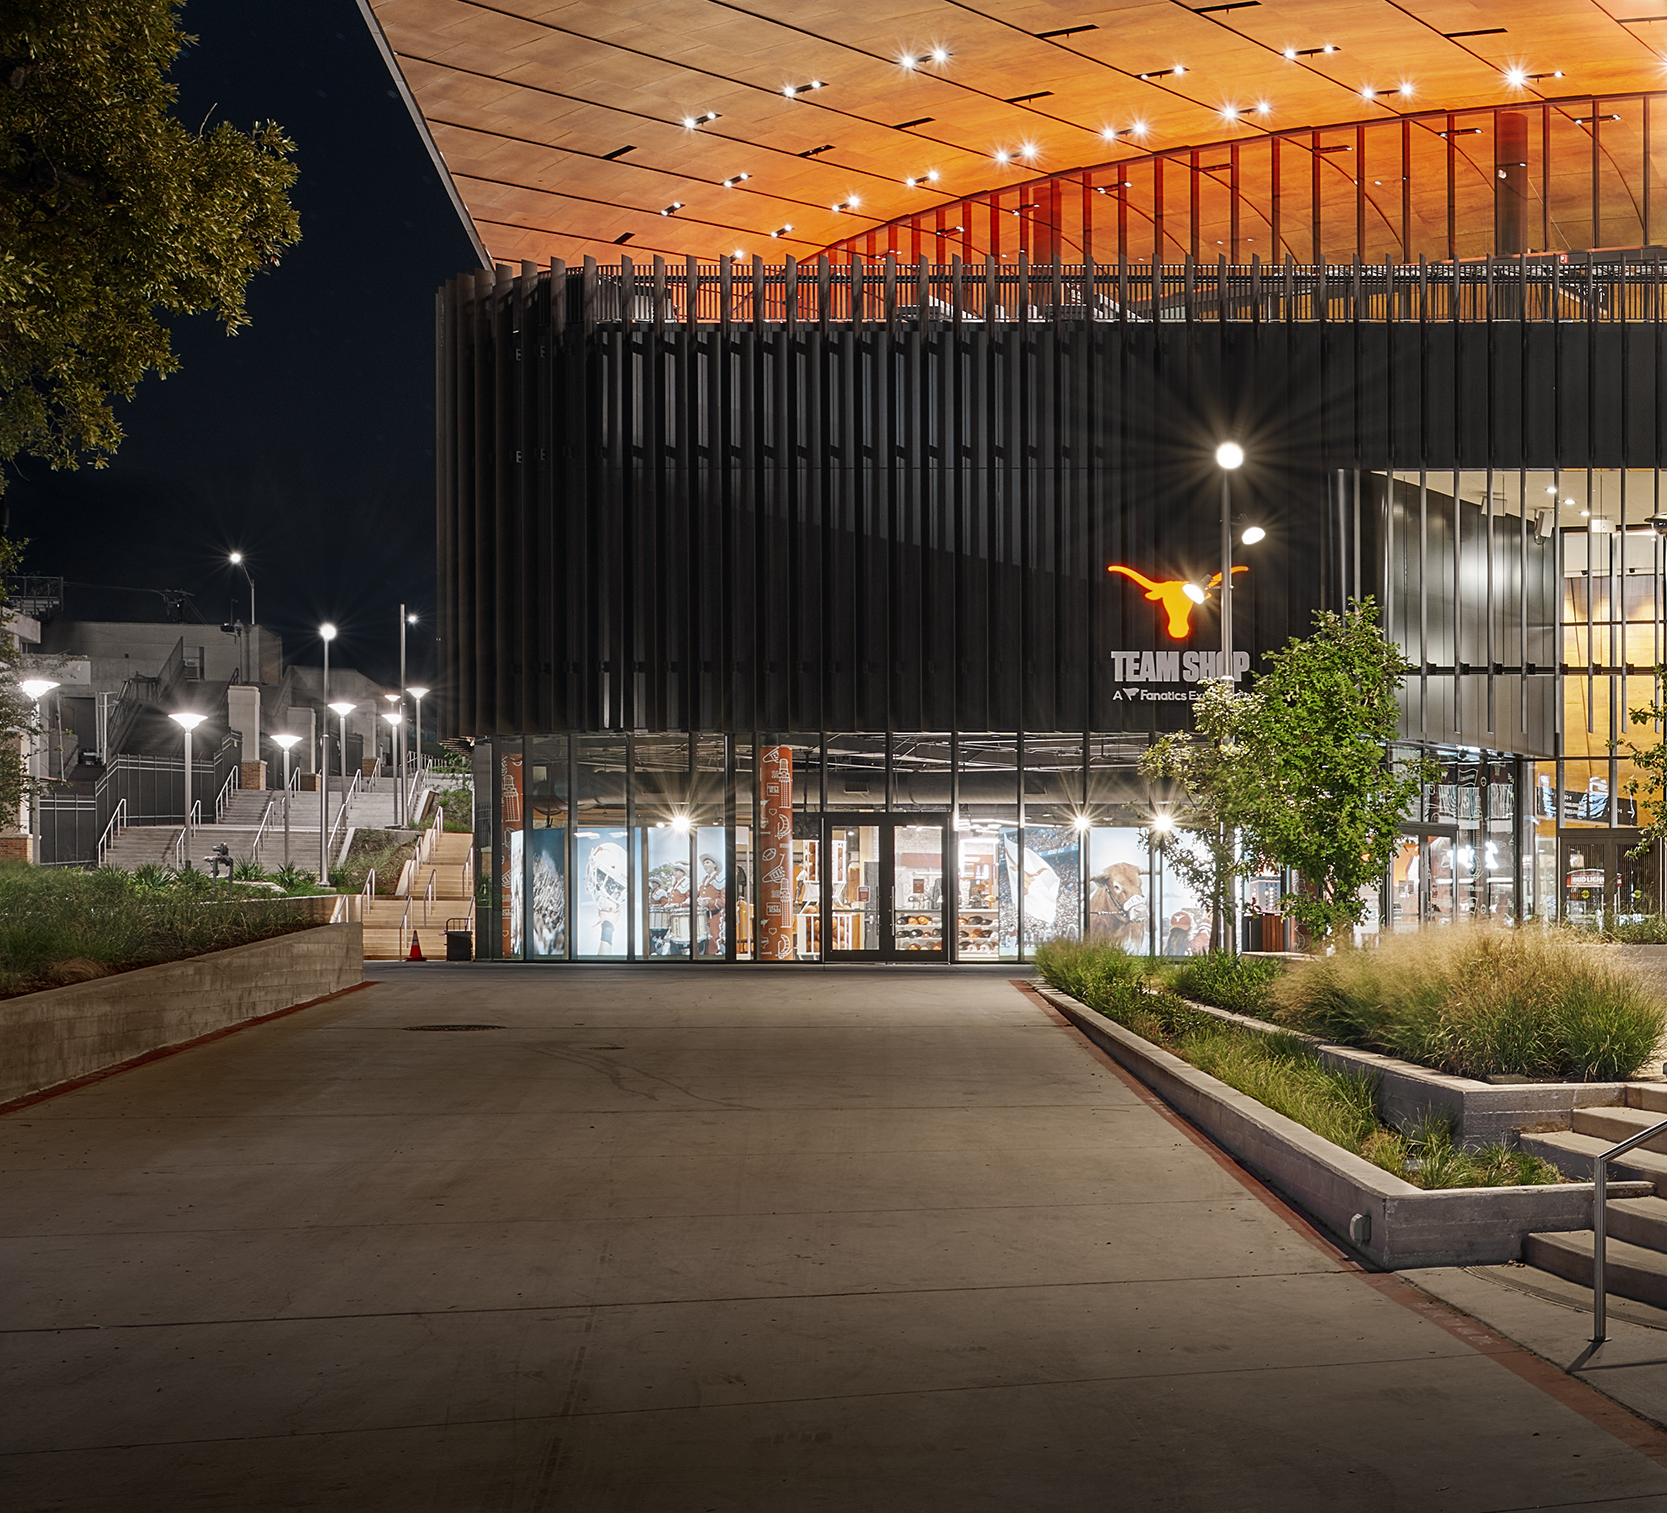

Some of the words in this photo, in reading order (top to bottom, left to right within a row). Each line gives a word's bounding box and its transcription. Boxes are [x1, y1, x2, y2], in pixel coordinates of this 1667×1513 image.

[1110, 651, 1180, 682] TEAM
[1112, 690, 1124, 701] A
[1140, 689, 1188, 701] Fanatics
[1572, 876, 1587, 884] BUD
